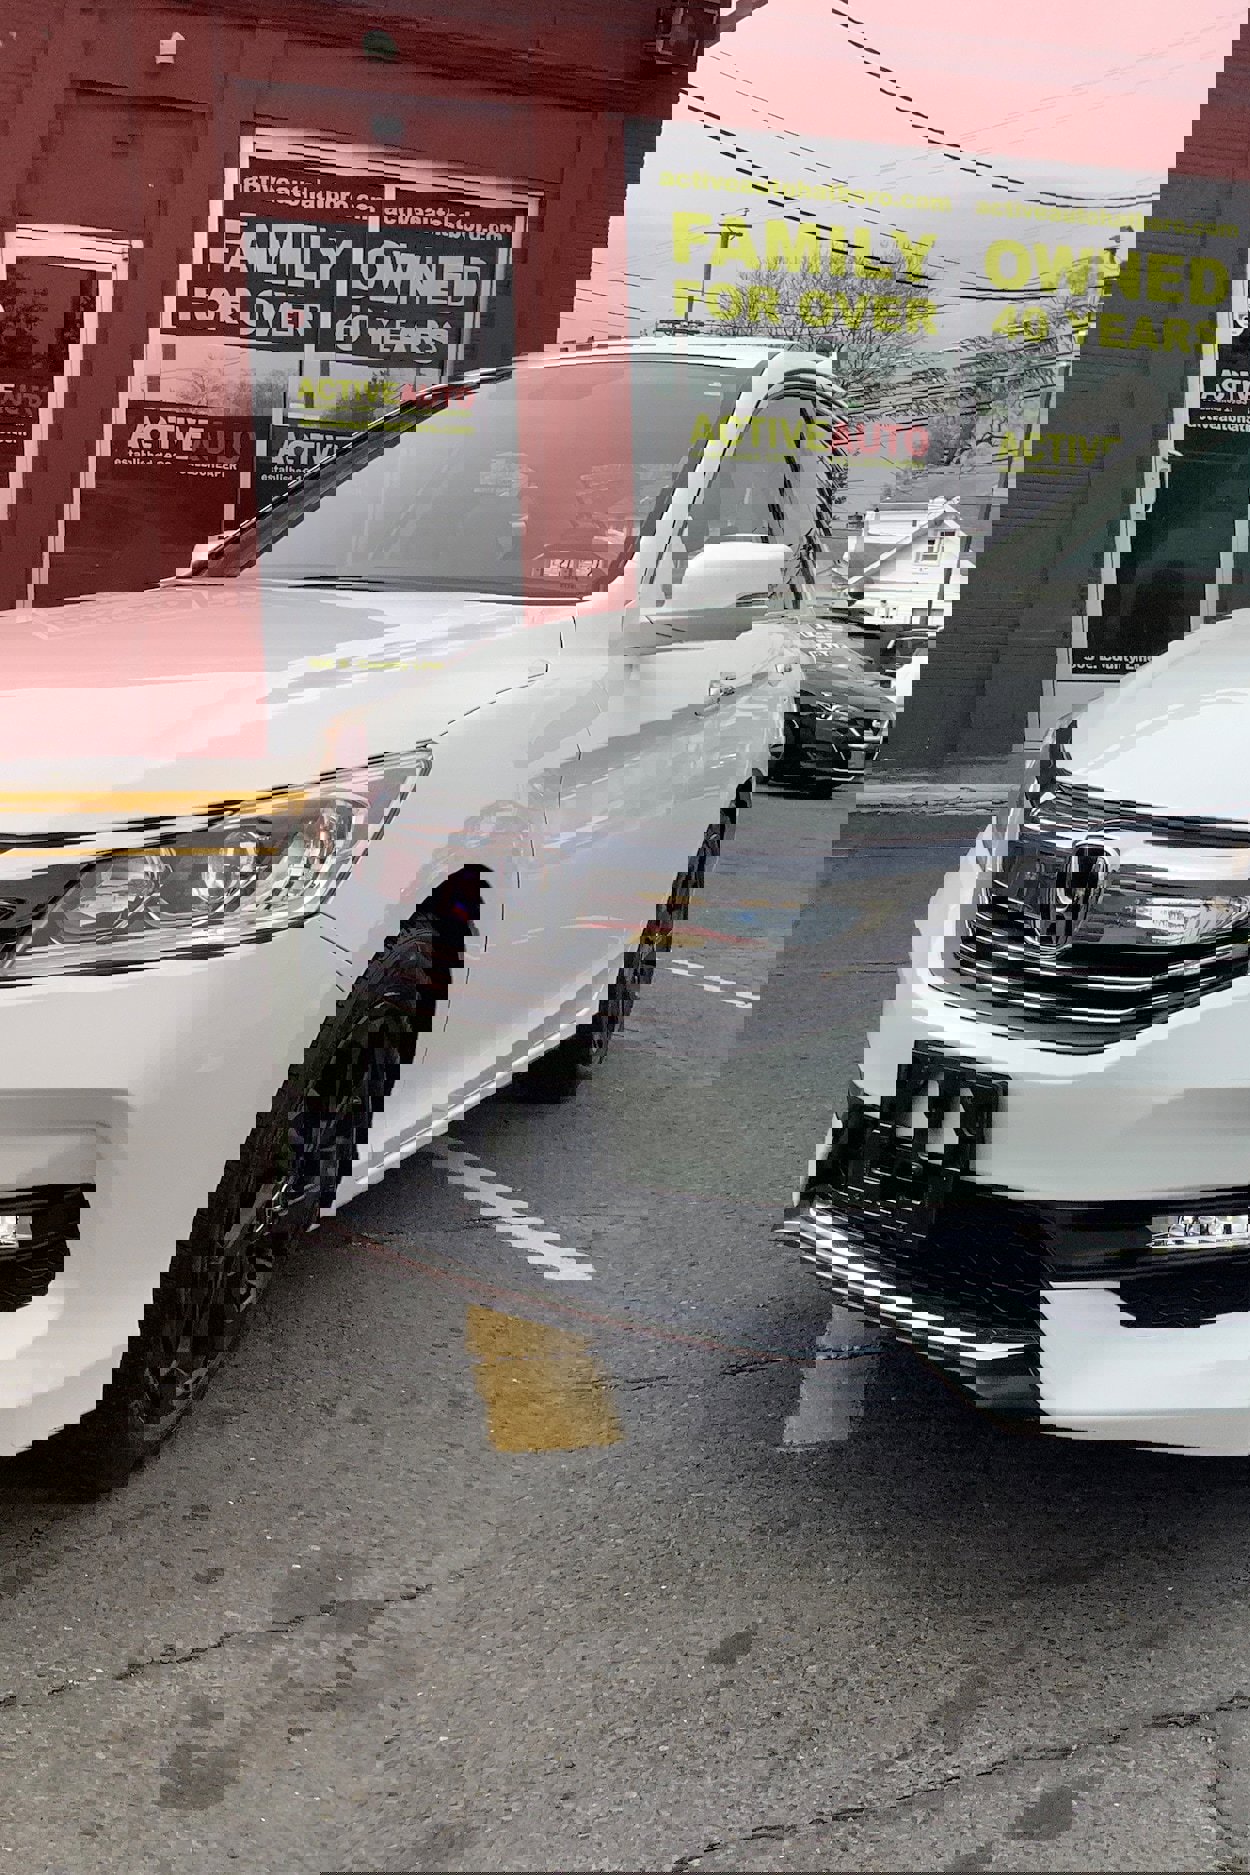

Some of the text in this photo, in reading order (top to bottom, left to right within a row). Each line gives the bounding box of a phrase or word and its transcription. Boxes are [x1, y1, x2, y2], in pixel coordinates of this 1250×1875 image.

[658, 168, 953, 214] activeautohatboro.com
[672, 211, 1231, 307] FAMILY OWNED
[672, 278, 1222, 355] FOR OVER 40 YEARS
